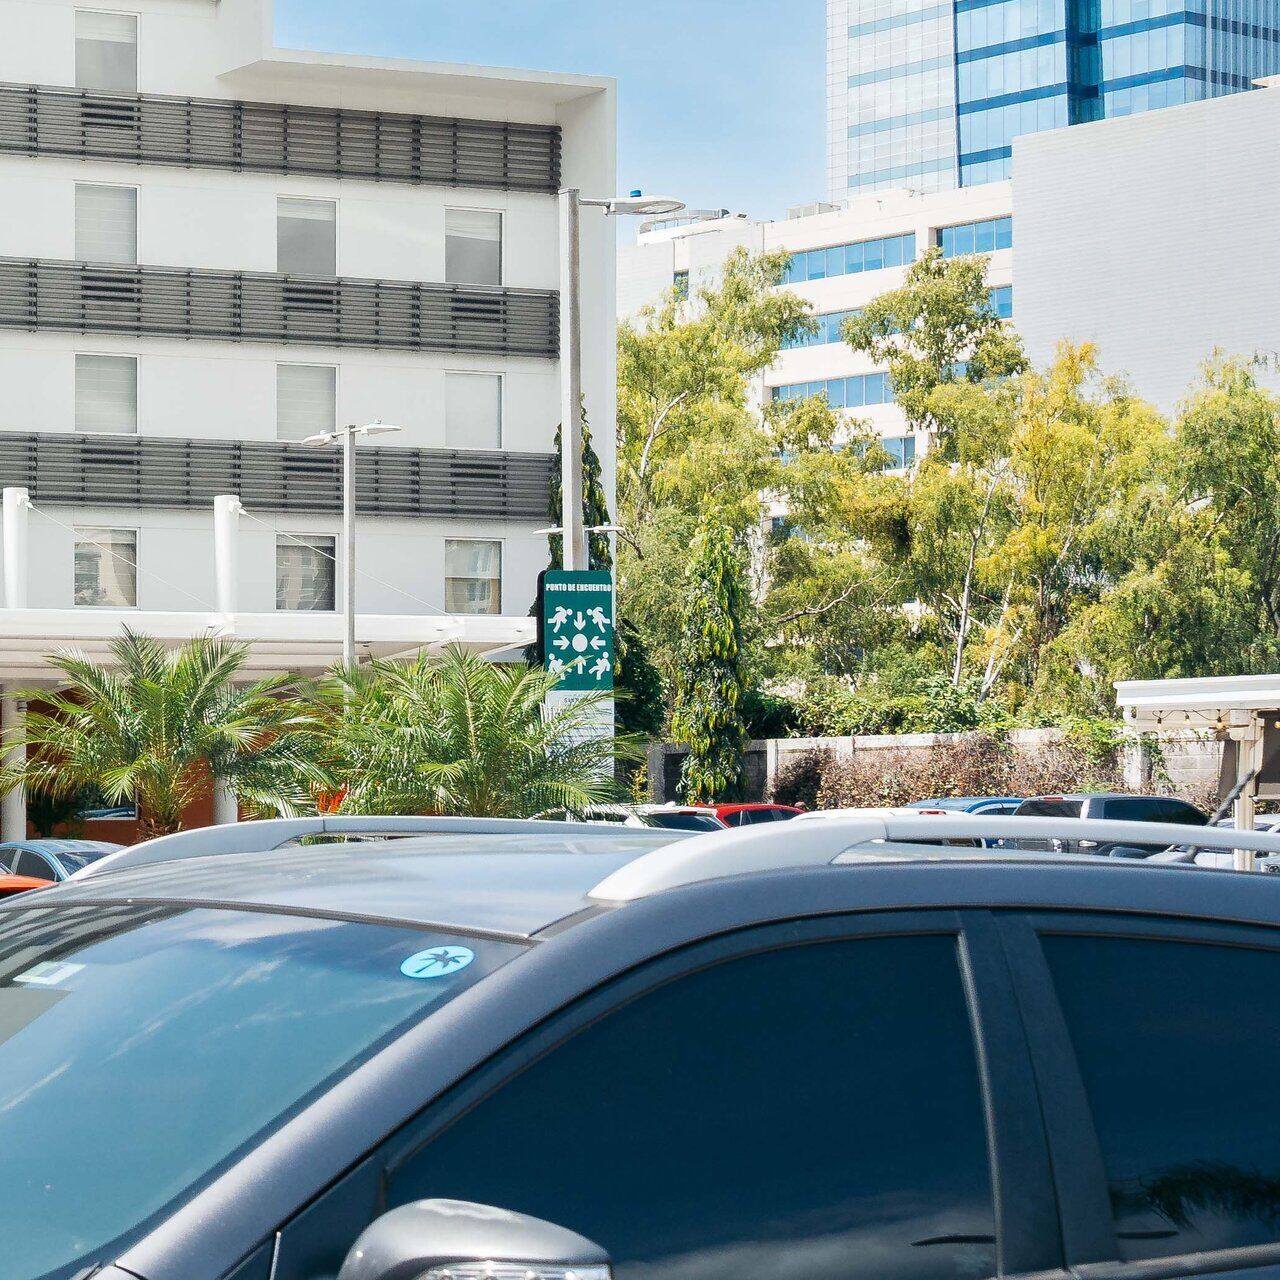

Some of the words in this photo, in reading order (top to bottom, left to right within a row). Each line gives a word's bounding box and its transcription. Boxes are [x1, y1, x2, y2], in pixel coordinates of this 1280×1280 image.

[545, 583, 567, 592] PUNTO
[567, 583, 576, 592] DE
[576, 583, 612, 592] ENCUENTRO
